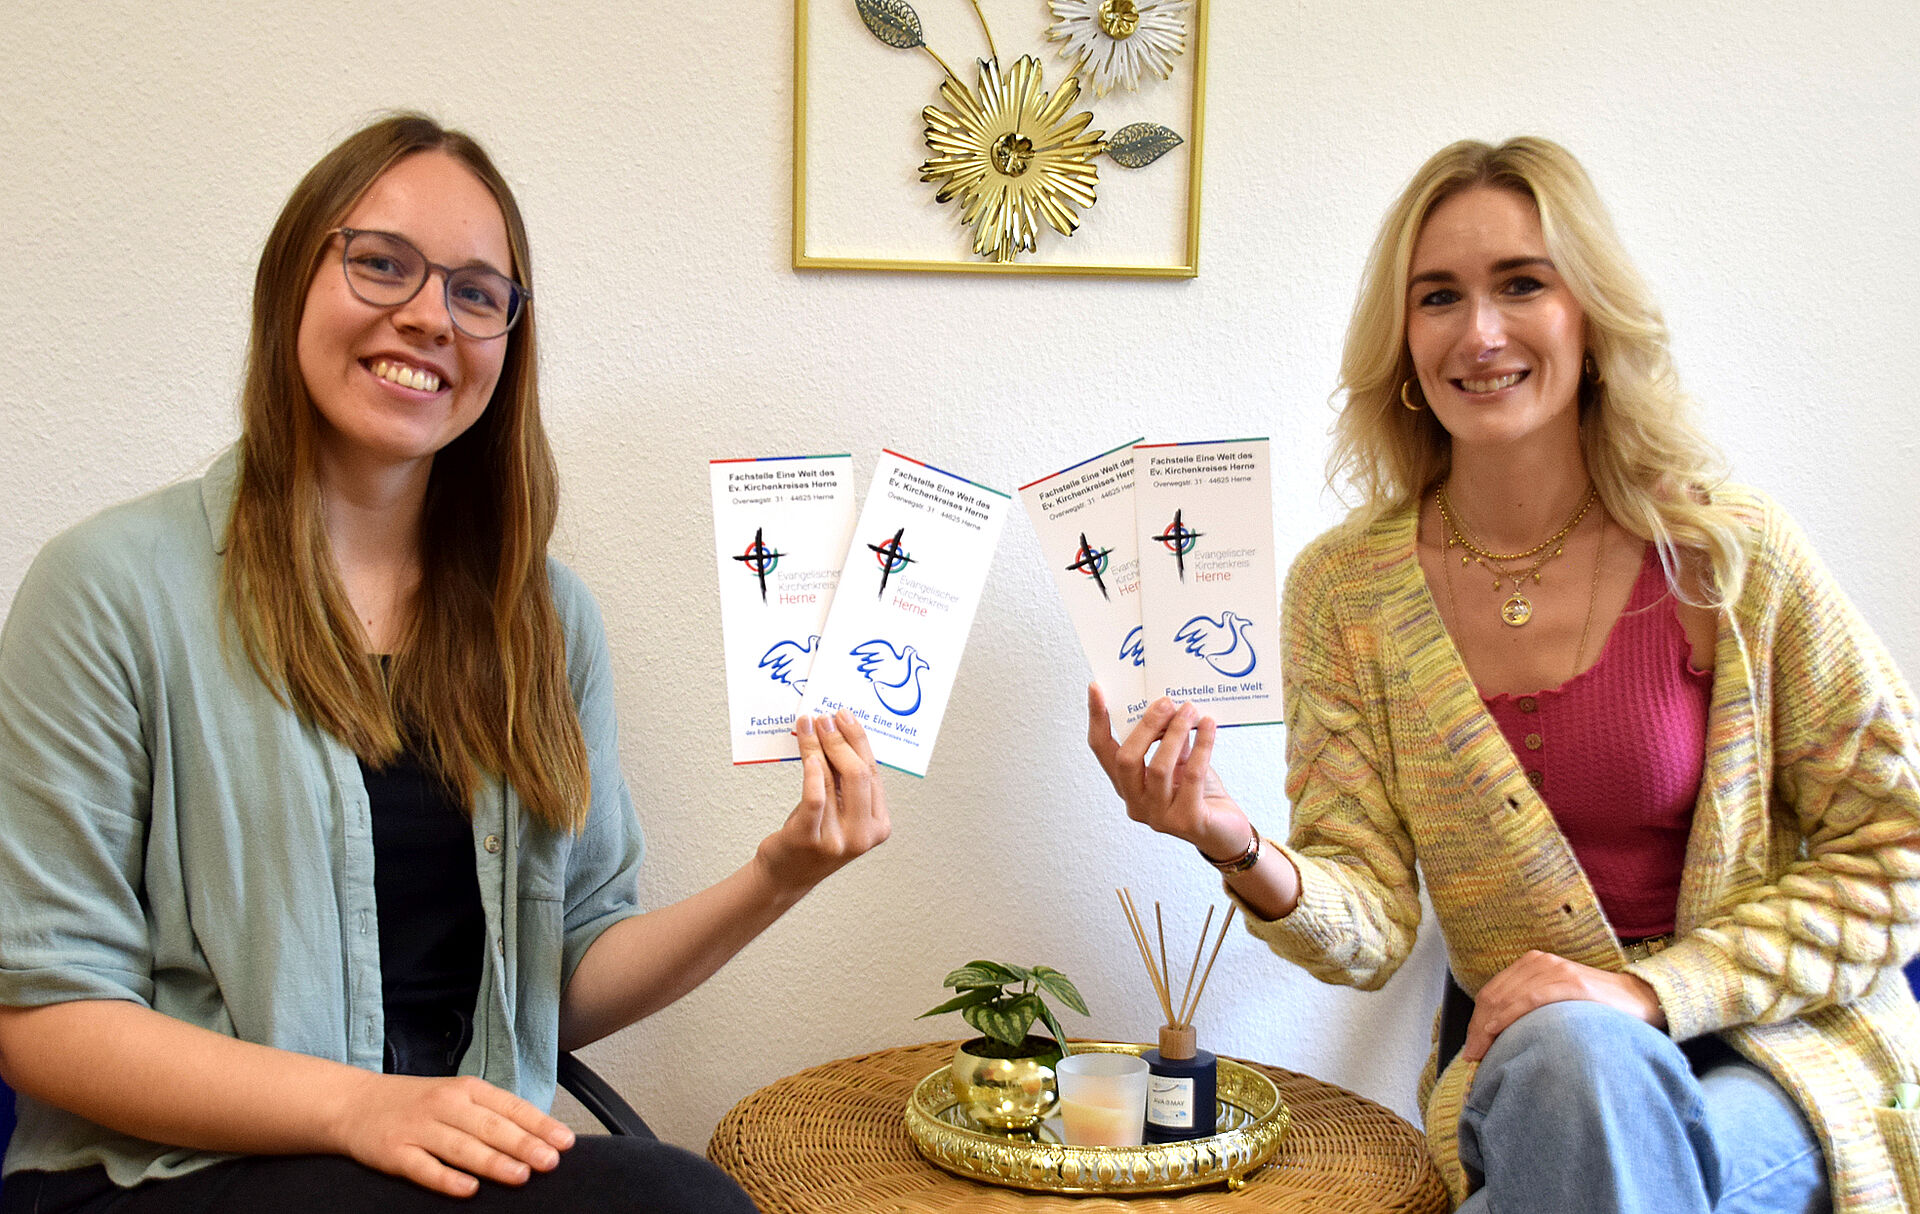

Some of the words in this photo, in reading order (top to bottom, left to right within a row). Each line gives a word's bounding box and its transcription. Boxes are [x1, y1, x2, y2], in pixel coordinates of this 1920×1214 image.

[1151, 456, 1194, 465] Fachstelle
[729, 473, 774, 481] Fachstelle
[776, 471, 795, 479] Eine
[1150, 468, 1162, 476] Ev.
[1165, 465, 1227, 475] Kirchenkreises
[744, 482, 809, 491] Kirchenkreises
[894, 468, 935, 489] Fachstelle
[937, 484, 955, 496] Eine
[957, 491, 975, 504] Welt
[976, 499, 990, 510] des
[1039, 480, 1080, 501] Fachstelle
[1081, 472, 1099, 483] Eine
[1100, 464, 1118, 475] Welt
[1042, 502, 1055, 511] Ev.
[1056, 477, 1115, 505] Kirchenkreises
[1116, 468, 1135, 479] Hern
[889, 478, 900, 488] Ev.
[903, 483, 963, 511] Kirchenkreises
[965, 506, 989, 520] Herne
[961, 520, 981, 530] Herne
[1195, 549, 1255, 560] Evangelischer
[1195, 560, 1250, 570] Kirchenkreis
[1196, 572, 1231, 582] Herne
[900, 575, 960, 602] Evangelischer
[780, 592, 816, 605] Herne
[897, 586, 948, 612] Kirchenkreis
[893, 596, 927, 617] Herne
[1166, 685, 1214, 696] Fachstelle
[1218, 684, 1237, 693] Eine
[1240, 683, 1263, 691] Welt
[751, 714, 796, 726] Fachstell
[873, 715, 892, 728] Eine
[895, 722, 917, 737] Welt
